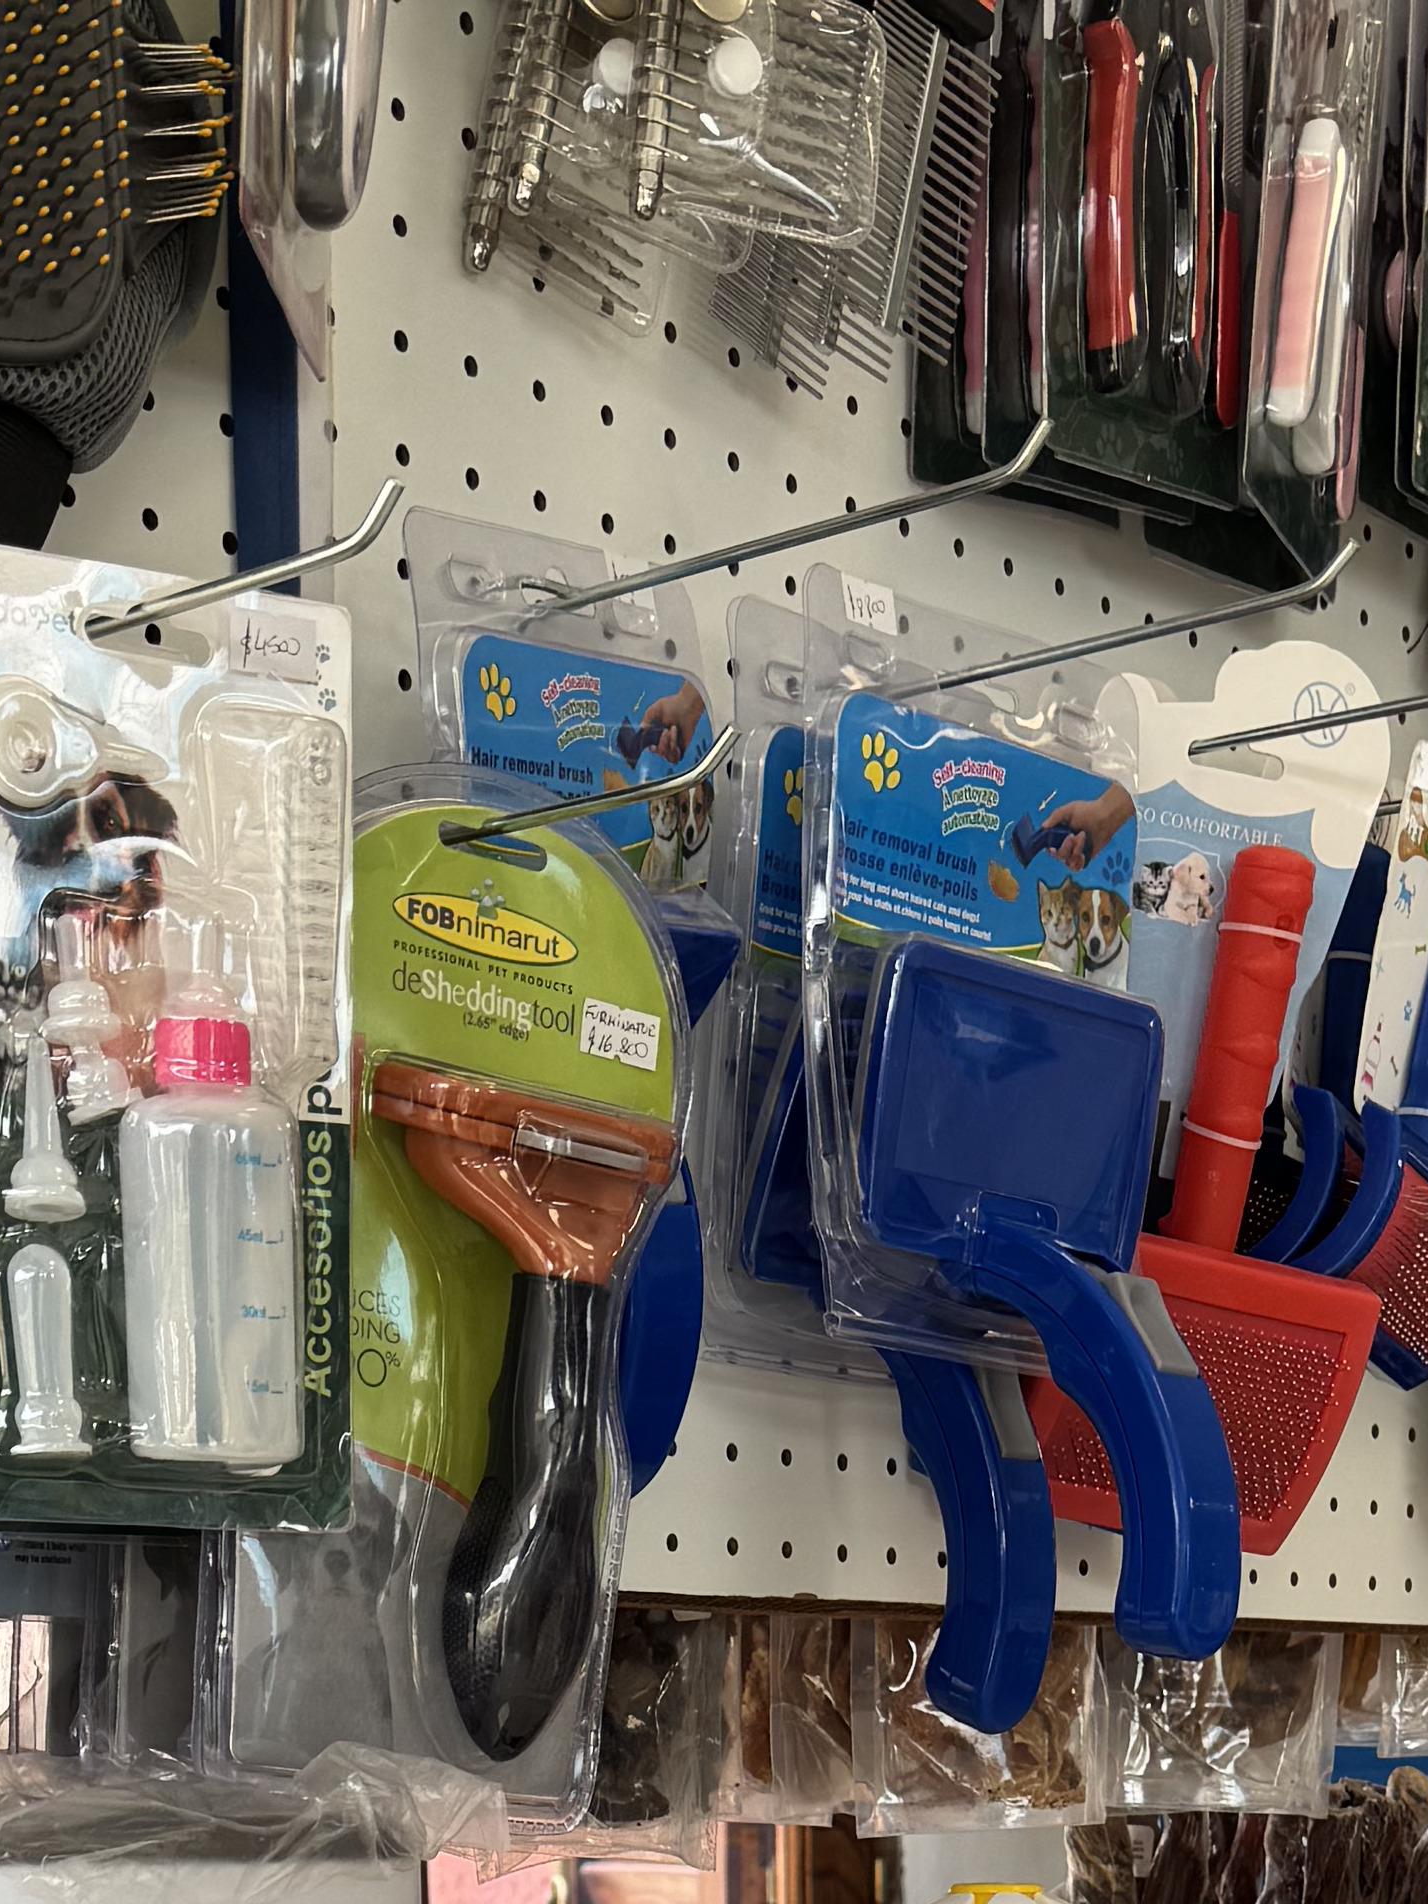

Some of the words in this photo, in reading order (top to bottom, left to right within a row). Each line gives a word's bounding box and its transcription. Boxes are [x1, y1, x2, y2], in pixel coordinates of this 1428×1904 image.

[471, 746, 500, 768] Hair
[502, 753, 555, 778] removal
[558, 762, 594, 785] brush
[931, 756, 1006, 789] Self-cleaning
[1159, 808, 1284, 848] COMFORTABLE
[872, 828, 933, 862] removal
[935, 845, 977, 876] brush
[889, 857, 979, 902] enlève-poils
[407, 896, 562, 960] FOBnimarut
[393, 939, 481, 972] PROFESSIONAL
[488, 963, 508, 979] PET
[513, 970, 574, 995] PRODUCTS
[498, 1020, 530, 1043] edge)
[304, 1129, 332, 1398] Accesorios
[350, 1347, 401, 1388] 0%
